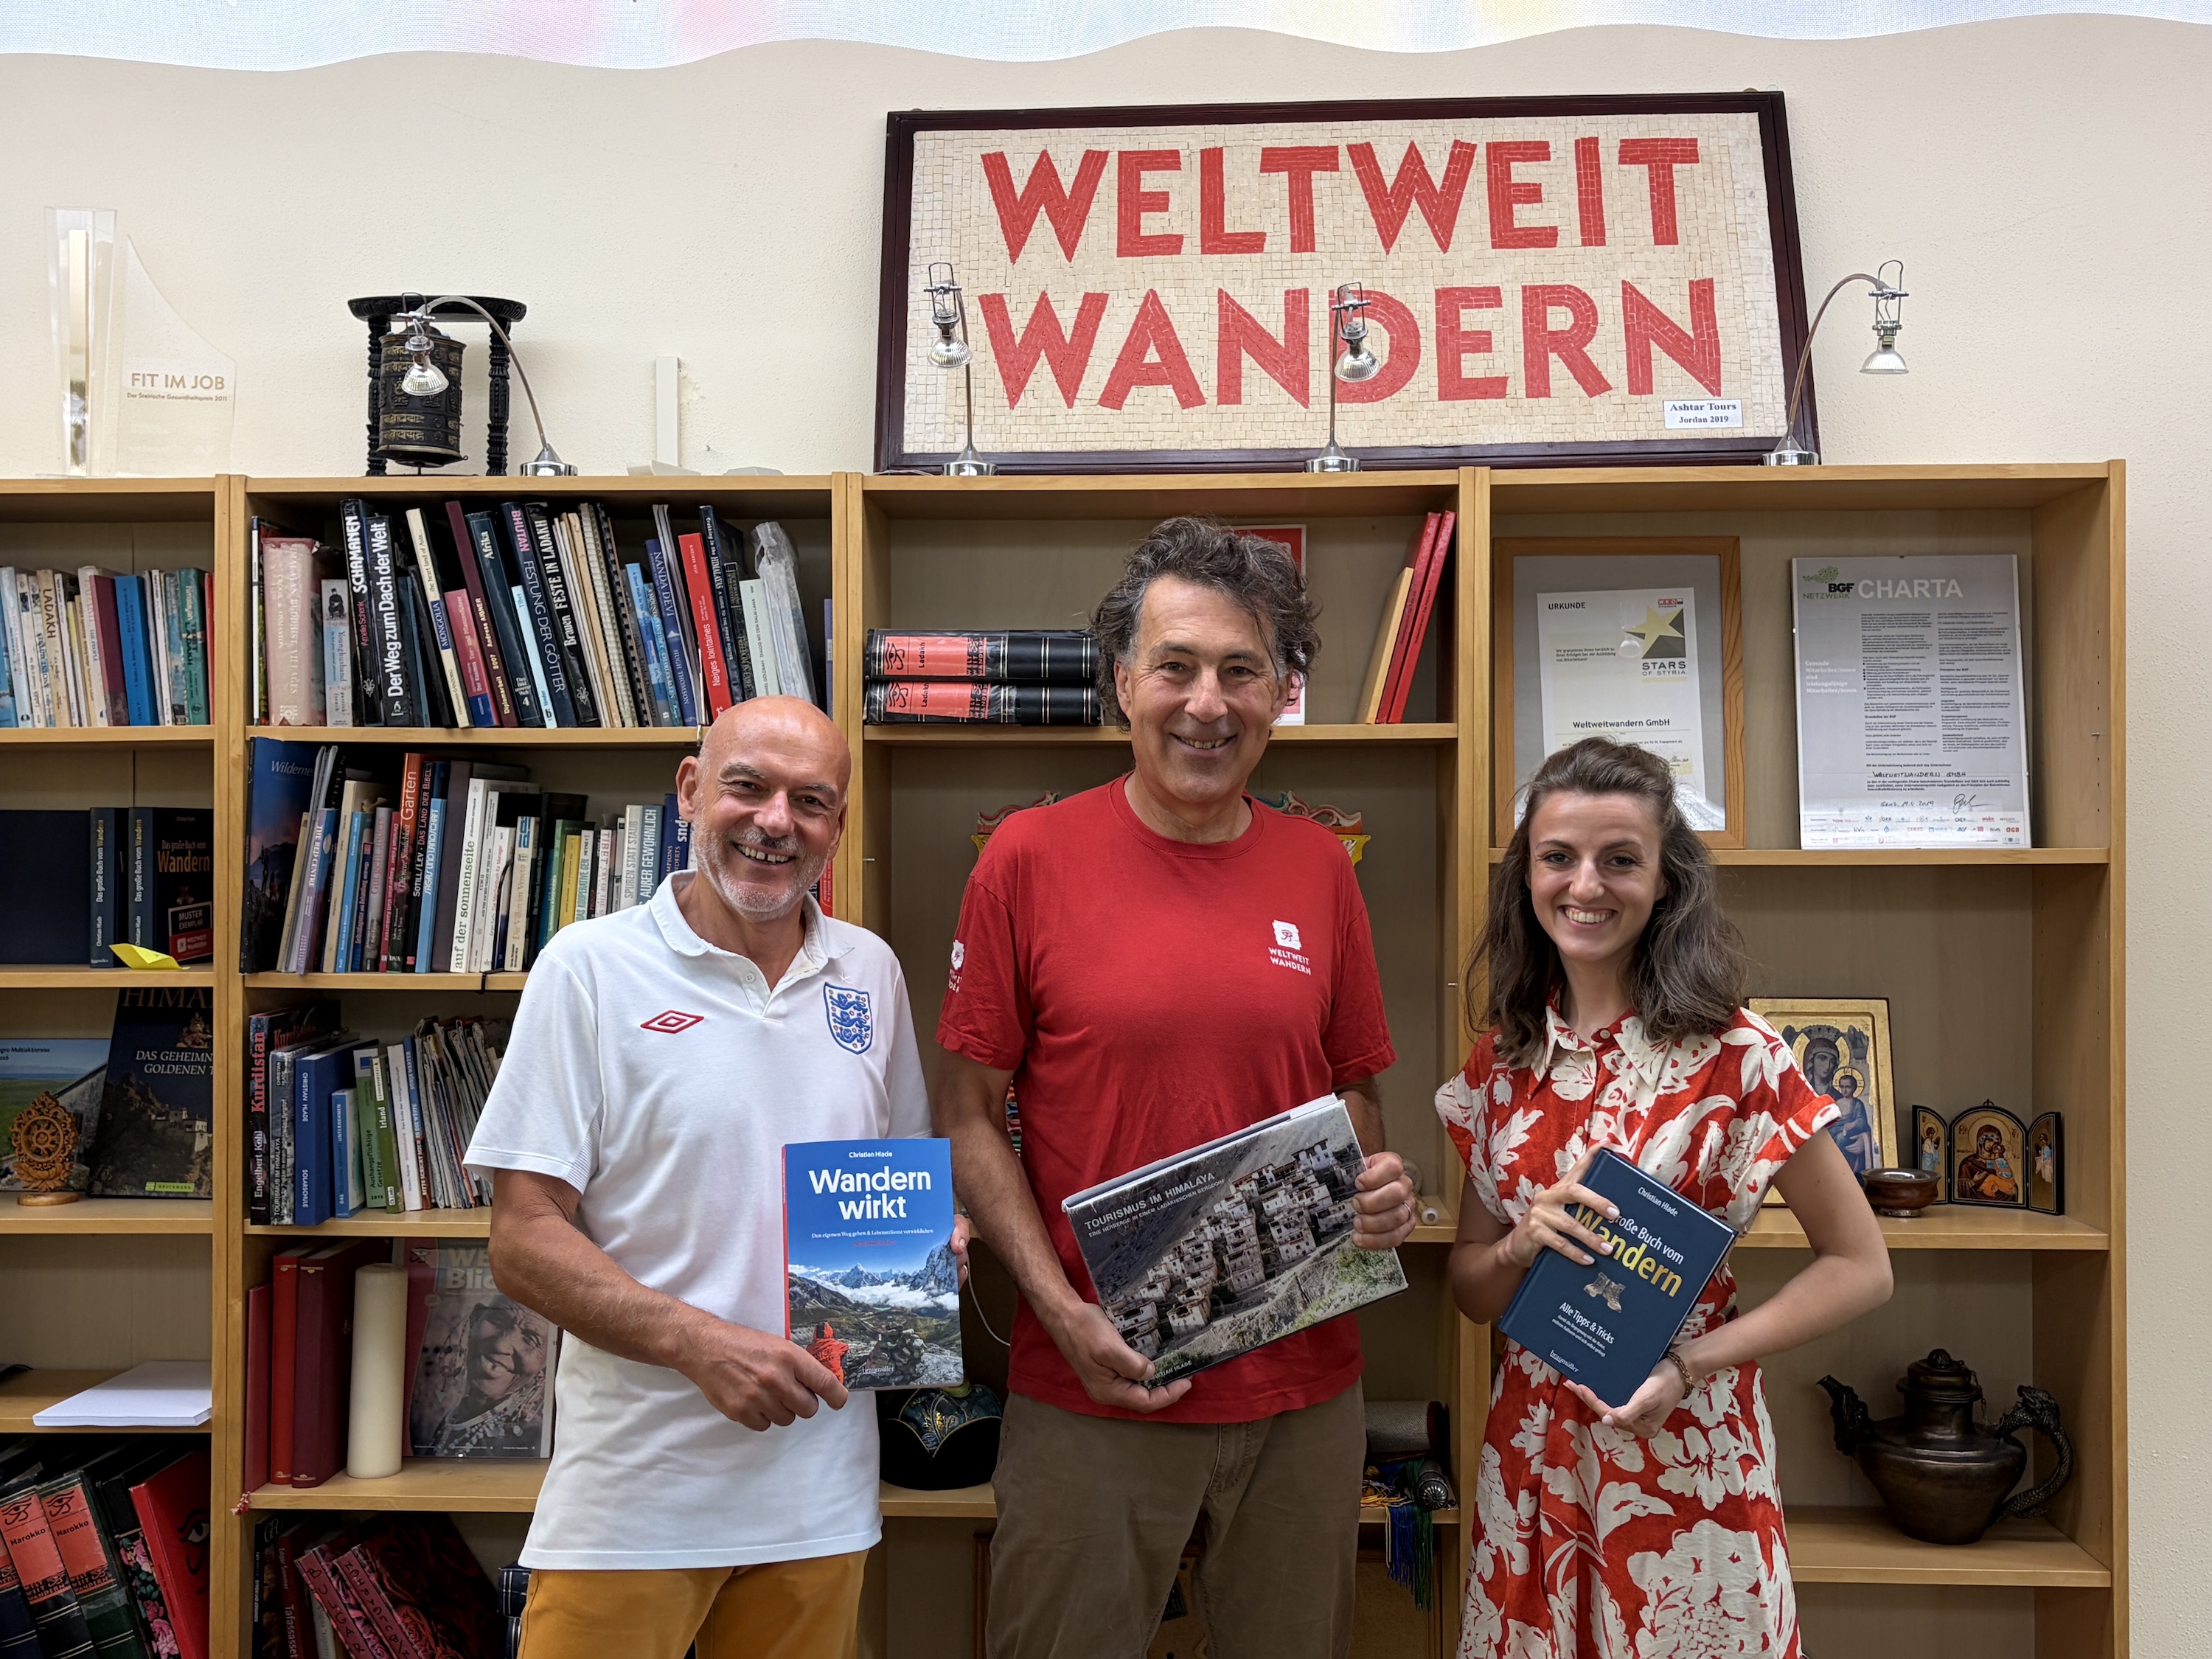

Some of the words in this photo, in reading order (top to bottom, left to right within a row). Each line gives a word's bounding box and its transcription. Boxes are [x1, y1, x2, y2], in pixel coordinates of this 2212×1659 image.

[981, 136, 1699, 264] WELTWEIT
[979, 279, 1720, 410] WANDERN
[131, 373, 159, 387] FIT
[164, 375, 186, 389] IM
[191, 375, 225, 390] JOB
[1670, 403, 1705, 411] Ashtar
[1707, 403, 1736, 411] Tours
[370, 522, 388, 553] Welt
[480, 531, 494, 559] Afrika
[511, 510, 530, 552] BHUTAN
[533, 519, 552, 560] LADAKH
[345, 516, 368, 594] SCHAMANEN
[376, 553, 392, 574] der
[544, 563, 554, 574] IN
[653, 551, 669, 590] NANDA
[662, 591, 675, 617] DEVI
[710, 556, 724, 589] HIMALAYAS
[378, 576, 395, 611] Dach
[524, 560, 546, 615] FESTUNG
[548, 577, 566, 610] FESTE
[1828, 583, 1854, 593] BGF
[1857, 579, 1964, 599] CHARTA
[43, 588, 57, 639] LADAKH
[1548, 602, 1586, 611] URKUNDE
[383, 612, 398, 640] zum
[431, 602, 449, 647] MONGOLIA
[537, 616, 553, 641] DER
[561, 615, 577, 647] Brauen
[703, 624, 715, 659] lointaines
[338, 630, 347, 682] Younghusband
[385, 641, 403, 672] Weg
[543, 643, 566, 693] GÖTTER
[672, 649, 684, 669] HUGH
[1642, 661, 1687, 670] STARS
[387, 672, 404, 697] Der
[677, 670, 690, 705] THOMSON
[709, 661, 721, 686] Neiges
[495, 676, 510, 714] Diplomarbeit
[921, 682, 929, 707] Ladakh
[1573, 719, 1644, 729] Weltweitwandern
[1646, 718, 1670, 727] GmbH
[422, 768, 432, 789] BIBEL
[400, 771, 417, 821] Gärten
[421, 791, 430, 807] DER
[419, 808, 428, 828] LAND
[96, 819, 104, 846] Wandern
[135, 819, 143, 846] Wandern
[417, 830, 426, 845] DAS
[628, 821, 638, 844] STAUB
[157, 850, 210, 872] Wandern
[602, 831, 610, 864] TIBET
[626, 846, 636, 868] STATT
[134, 860, 142, 874] Buch
[413, 852, 425, 897] SOTILL/LEV
[459, 841, 475, 918] sonnenseite
[625, 870, 636, 898] SPUREN
[178, 910, 203, 921] MUSTER
[456, 922, 467, 943] der
[453, 946, 465, 969] auf
[1268, 947, 1310, 966] WELTWEIT
[1270, 956, 1312, 977] WANDERN
[136, 1050, 158, 1061] DAS
[144, 1063, 206, 1075] GOLDENEN
[251, 1032, 265, 1113] Kurdistan
[378, 1107, 388, 1129] Irland
[365, 1130, 376, 1188] Aushangpflichtige
[254, 1154, 264, 1197] Engelbert
[808, 1166, 931, 1194] Wandern
[838, 1193, 907, 1220] wirkt
[1085, 1200, 1147, 1230] TOURISMUS
[1149, 1193, 1163, 1205] IM
[1165, 1172, 1215, 1198] HIMALAYA
[1088, 1229, 1102, 1238] EINE
[1102, 1219, 1131, 1233] HERBERGE
[1139, 1208, 1156, 1218] EINEM
[1157, 1191, 1197, 1211] LADAKHISCHEN
[1197, 1179, 1225, 1194] BERGDORF
[1638, 1186, 1662, 1206] Christian
[1661, 1201, 1679, 1217] Hlade
[1574, 1204, 1683, 1298] Wandern
[1637, 1227, 1663, 1251] Buch
[1663, 1245, 1684, 1265] vom
[1559, 1302, 1573, 1317] Alle
[1573, 1310, 1591, 1328] Tipps
[1589, 1322, 1597, 1332] &
[1596, 1326, 1615, 1344] Tricks
[10, 1528, 46, 1546] Marokko
[56, 1520, 89, 1537] Marokko
